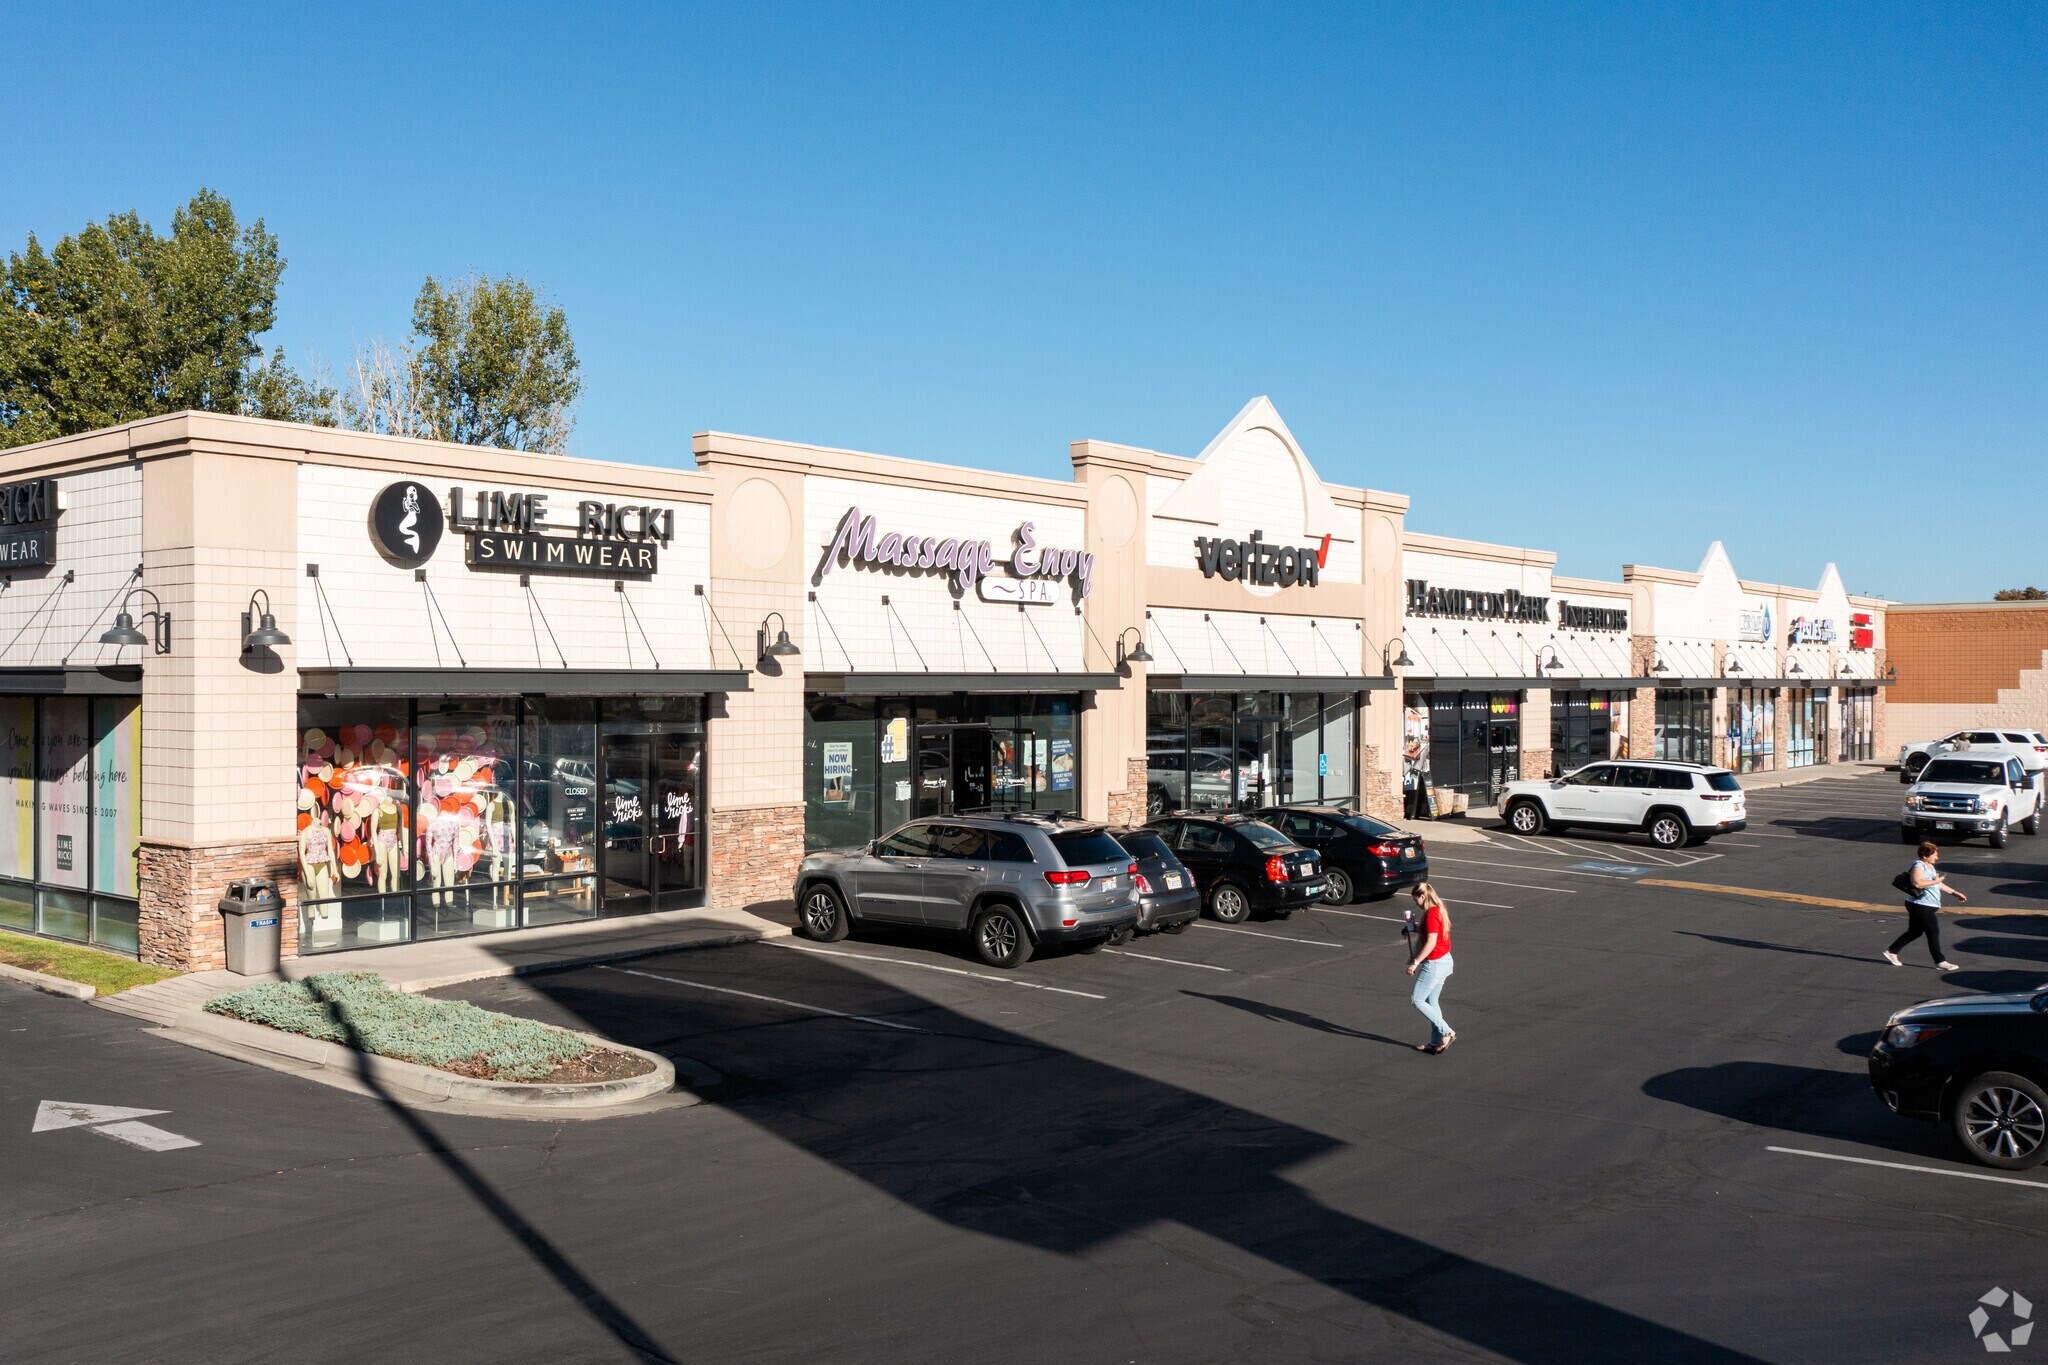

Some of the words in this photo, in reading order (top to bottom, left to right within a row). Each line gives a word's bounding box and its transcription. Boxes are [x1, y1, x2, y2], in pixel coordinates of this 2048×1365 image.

[451, 486, 549, 531] LIME
[579, 500, 674, 541] RICKI
[480, 538, 653, 569] SWIMWEAR
[822, 506, 995, 589] Massage
[1015, 521, 1095, 598] Envy
[1198, 529, 1320, 588] verizon
[1018, 580, 1048, 600] SPA
[829, 754, 848, 763] NOW
[825, 765, 852, 774] HIRING
[565, 787, 588, 796] CLOSED
[616, 796, 640, 811] lime
[667, 792, 690, 807] lime
[49, 803, 70, 813] WAVES
[100, 808, 117, 818] 2007
[613, 806, 643, 823] ricki
[58, 840, 72, 850] LIME
[58, 851, 72, 860] RICKI
[256, 919, 273, 927] TRASH
